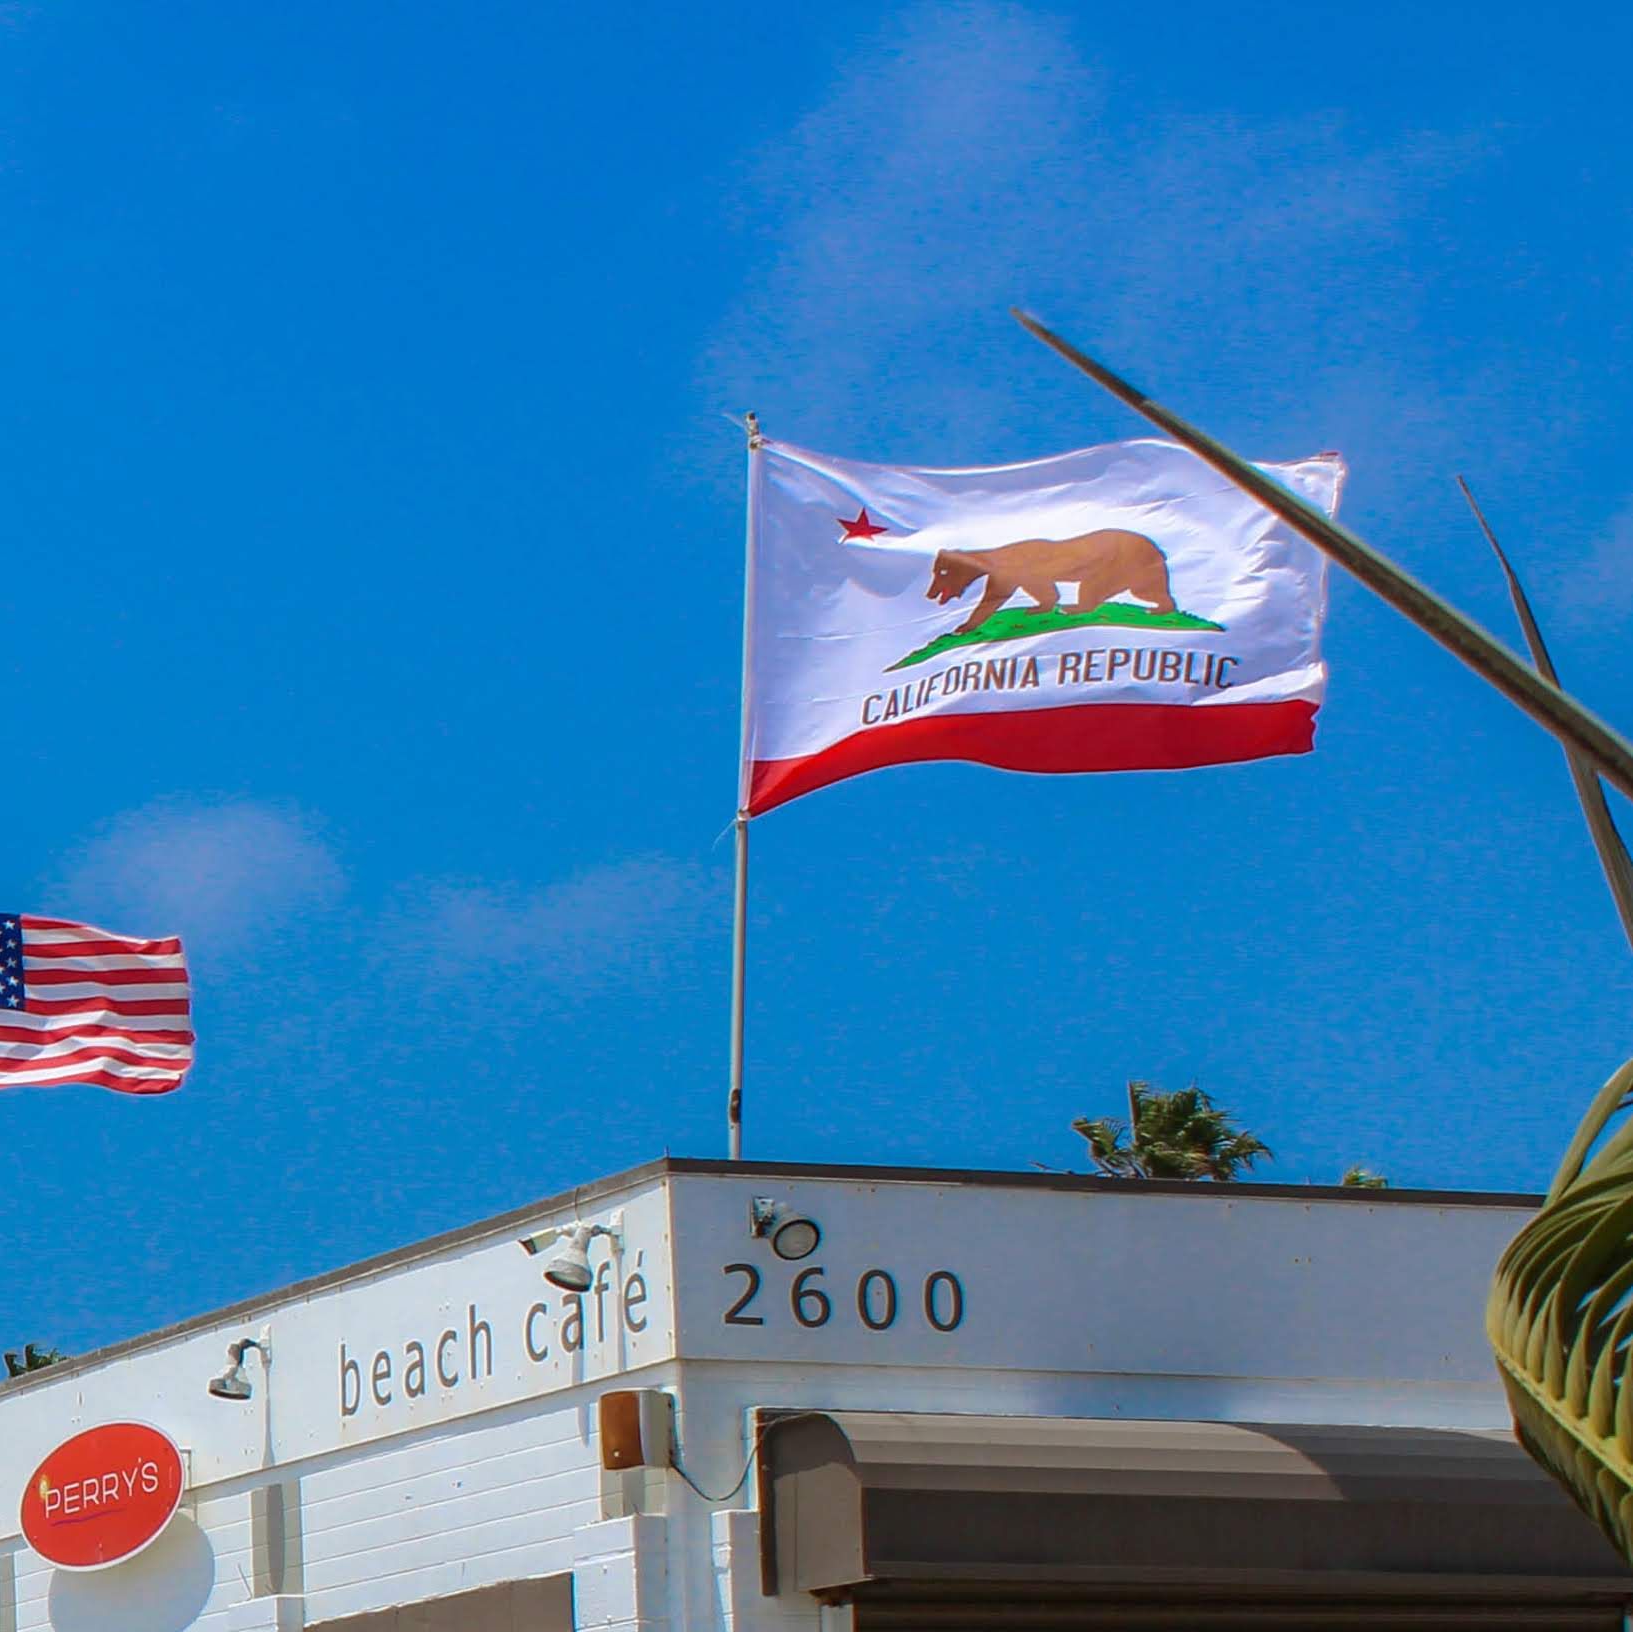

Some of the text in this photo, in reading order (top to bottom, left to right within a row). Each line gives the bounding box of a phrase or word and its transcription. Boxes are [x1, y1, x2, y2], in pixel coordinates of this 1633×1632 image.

[861, 648, 1239, 726] CALIFORNIA REPUBLIC
[339, 1250, 648, 1417] beach café
[723, 1263, 962, 1332] 2600
[44, 1457, 159, 1519] PERRY'S
